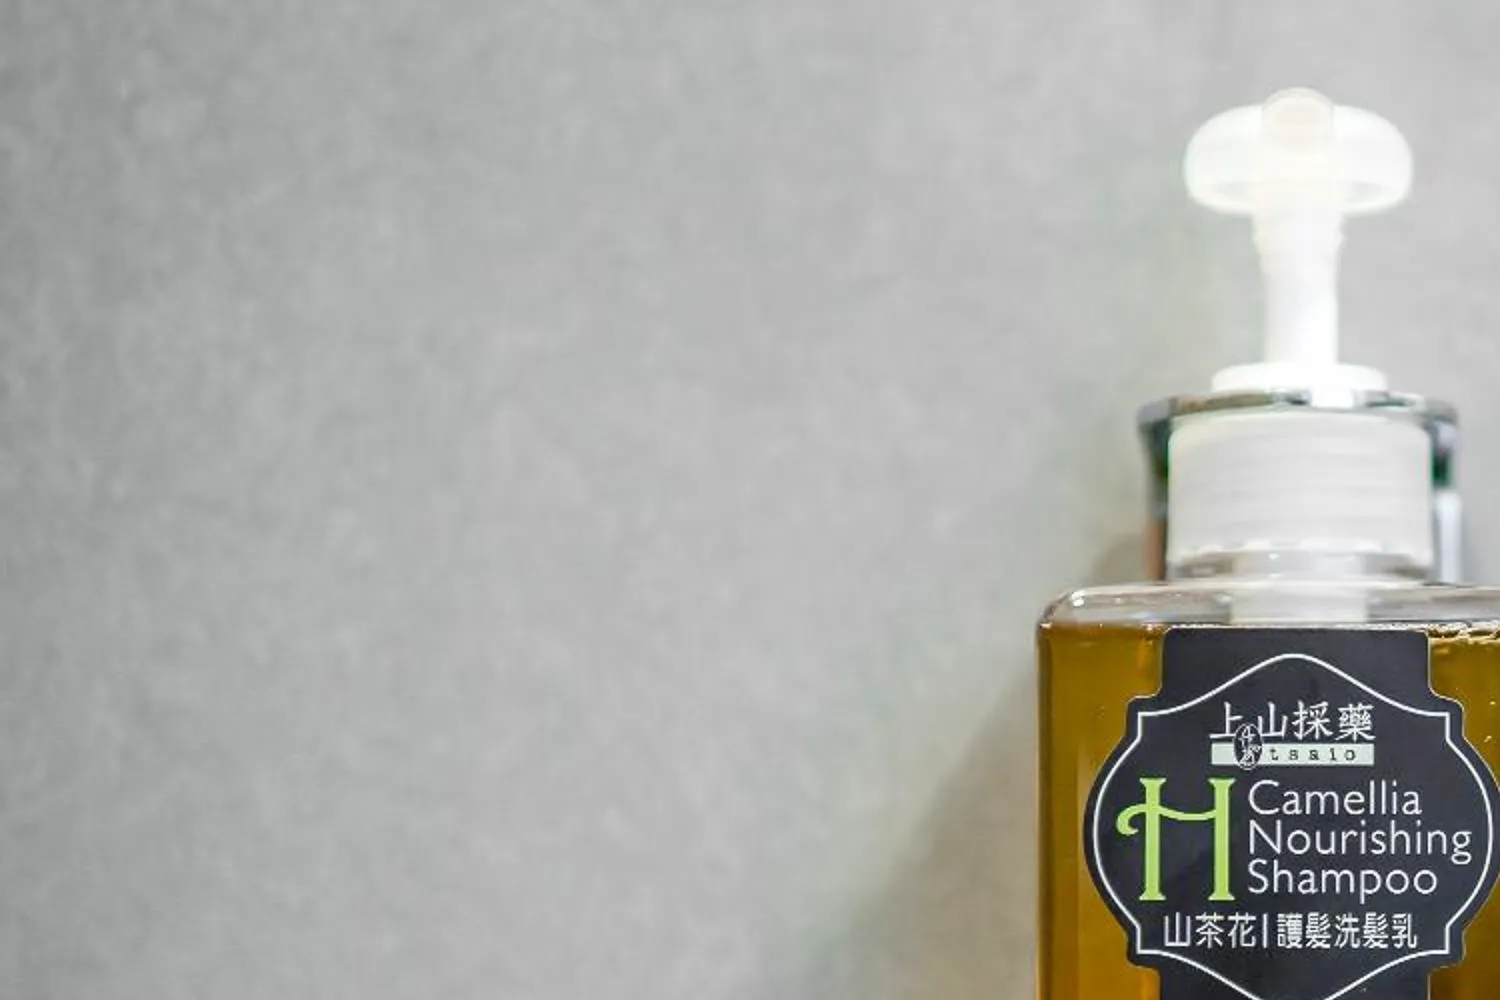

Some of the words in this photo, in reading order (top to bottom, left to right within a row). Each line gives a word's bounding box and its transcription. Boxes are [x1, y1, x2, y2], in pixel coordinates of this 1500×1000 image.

[1209, 700, 1376, 741] 上山採藥
[1269, 745, 1357, 761] tsaio
[1248, 779, 1422, 816] Camellia
[1116, 777, 1236, 901] H
[1248, 820, 1472, 865] Nourishing
[1248, 858, 1438, 904] Shampoo
